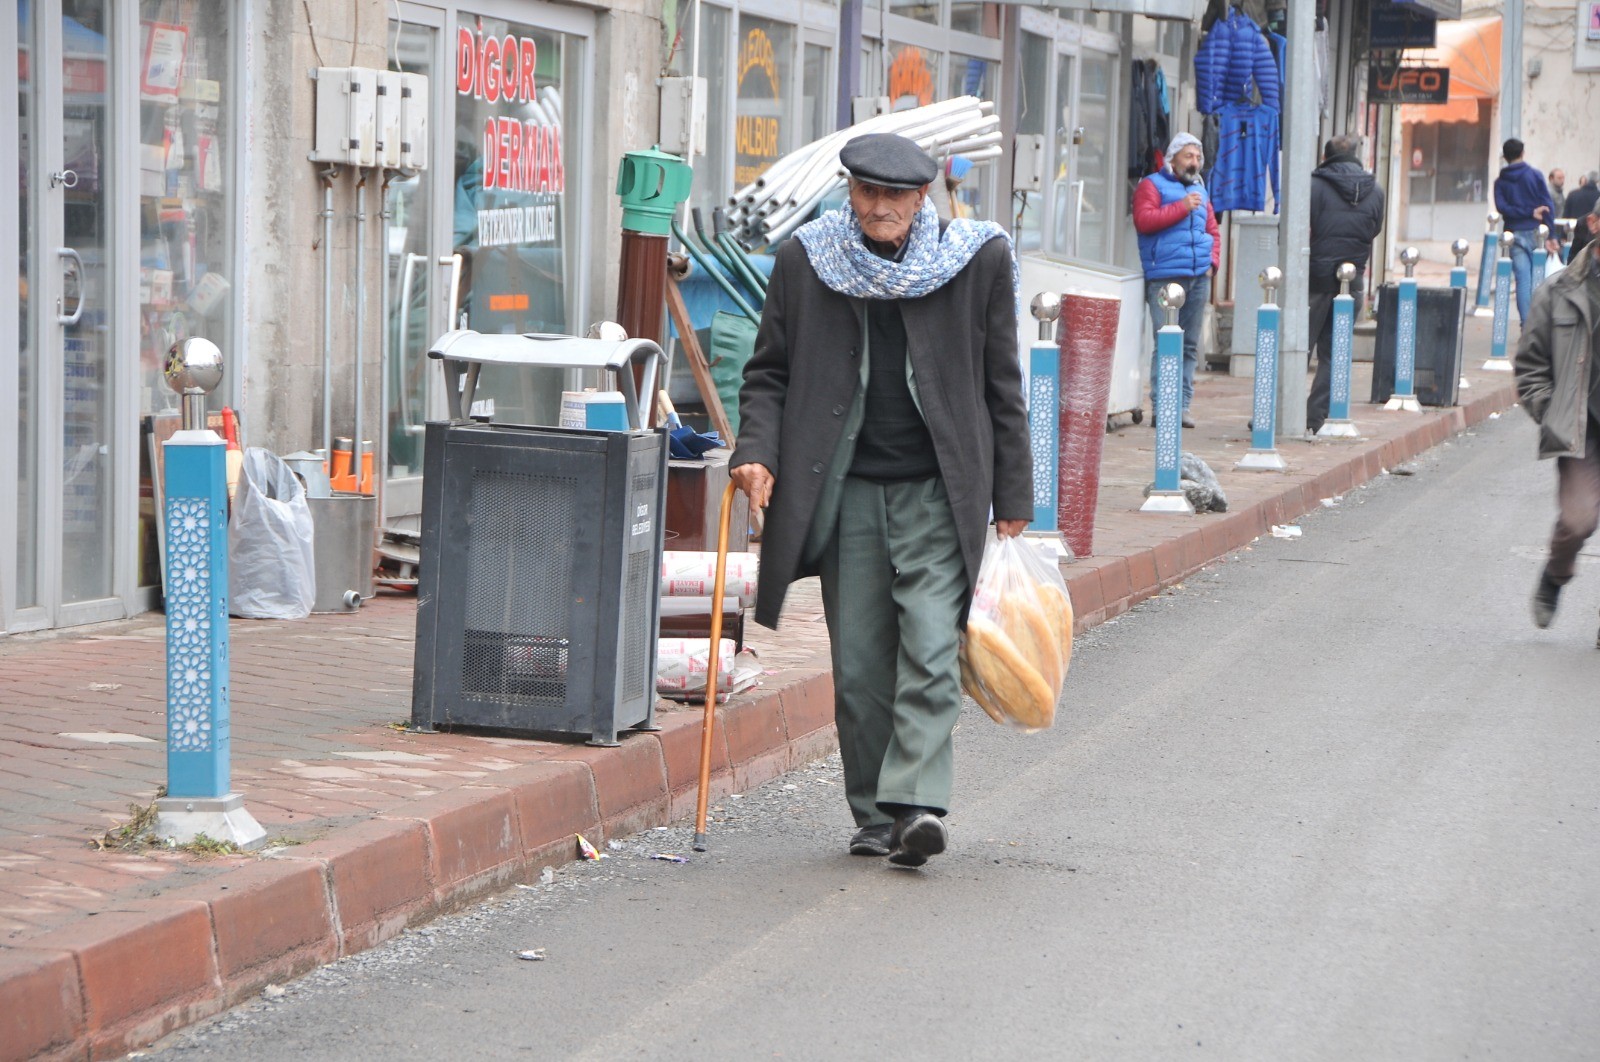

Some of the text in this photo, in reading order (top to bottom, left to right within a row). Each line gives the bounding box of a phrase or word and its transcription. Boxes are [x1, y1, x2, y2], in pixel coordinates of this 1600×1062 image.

[456, 15, 537, 104] DİGOR
[1377, 71, 1441, 91] UFO
[483, 116, 564, 196] DERMAN
